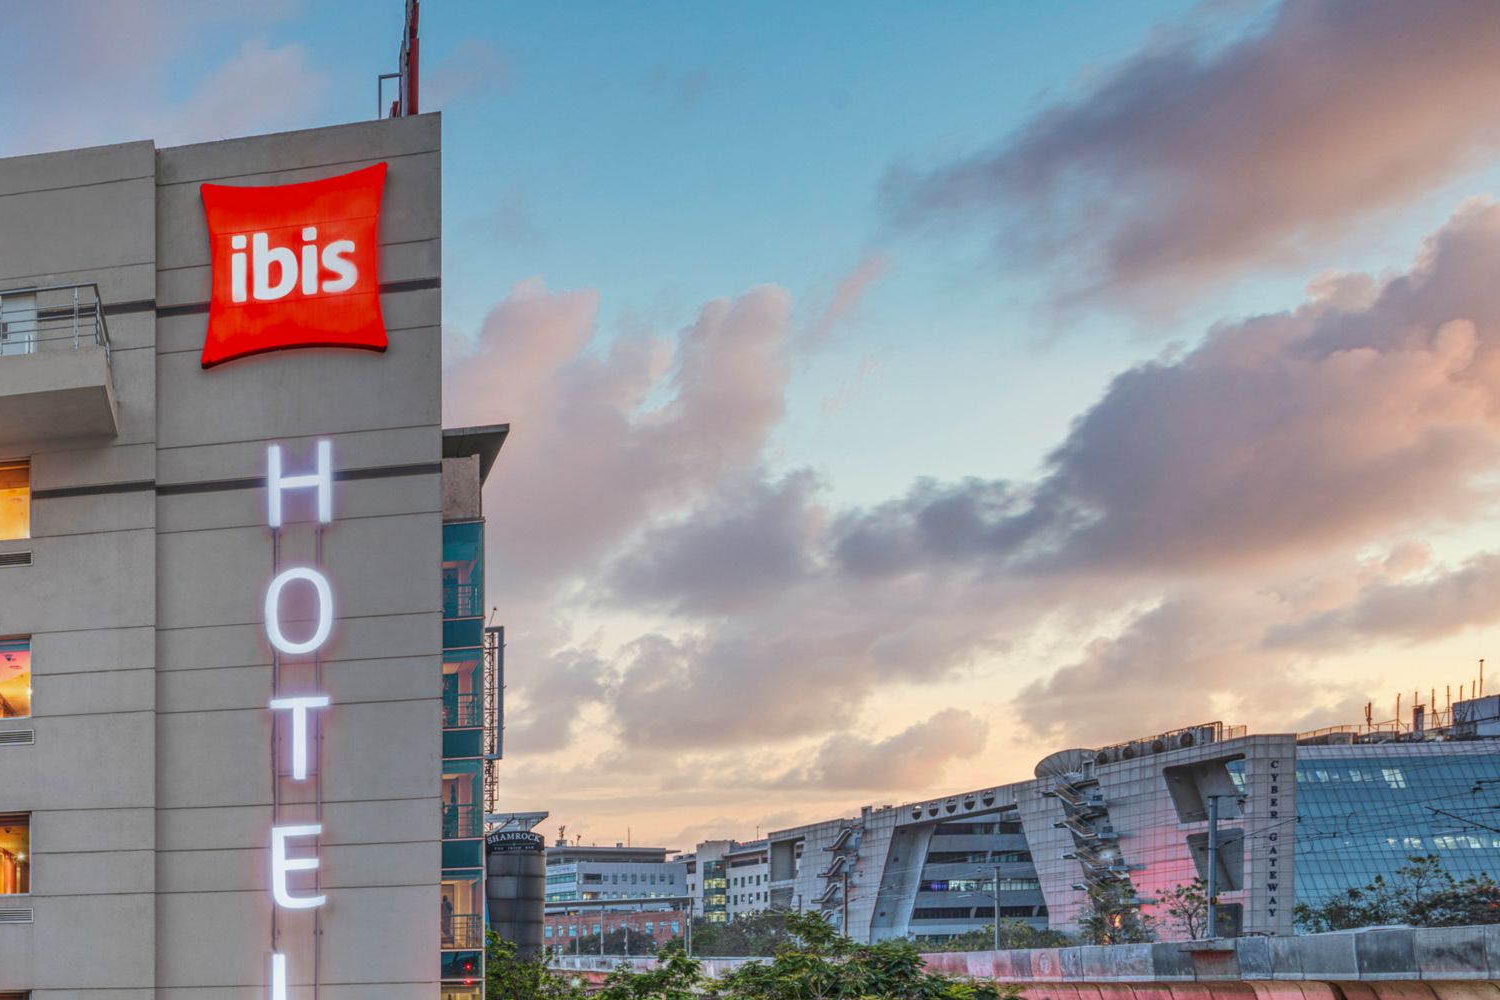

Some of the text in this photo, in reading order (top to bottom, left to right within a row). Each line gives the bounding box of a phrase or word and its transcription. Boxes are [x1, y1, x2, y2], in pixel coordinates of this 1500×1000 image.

[230, 227, 358, 303] ibis
[487, 833, 540, 845] SHAMROCK
[1267, 760, 1280, 917] CYBER GATEWAY
